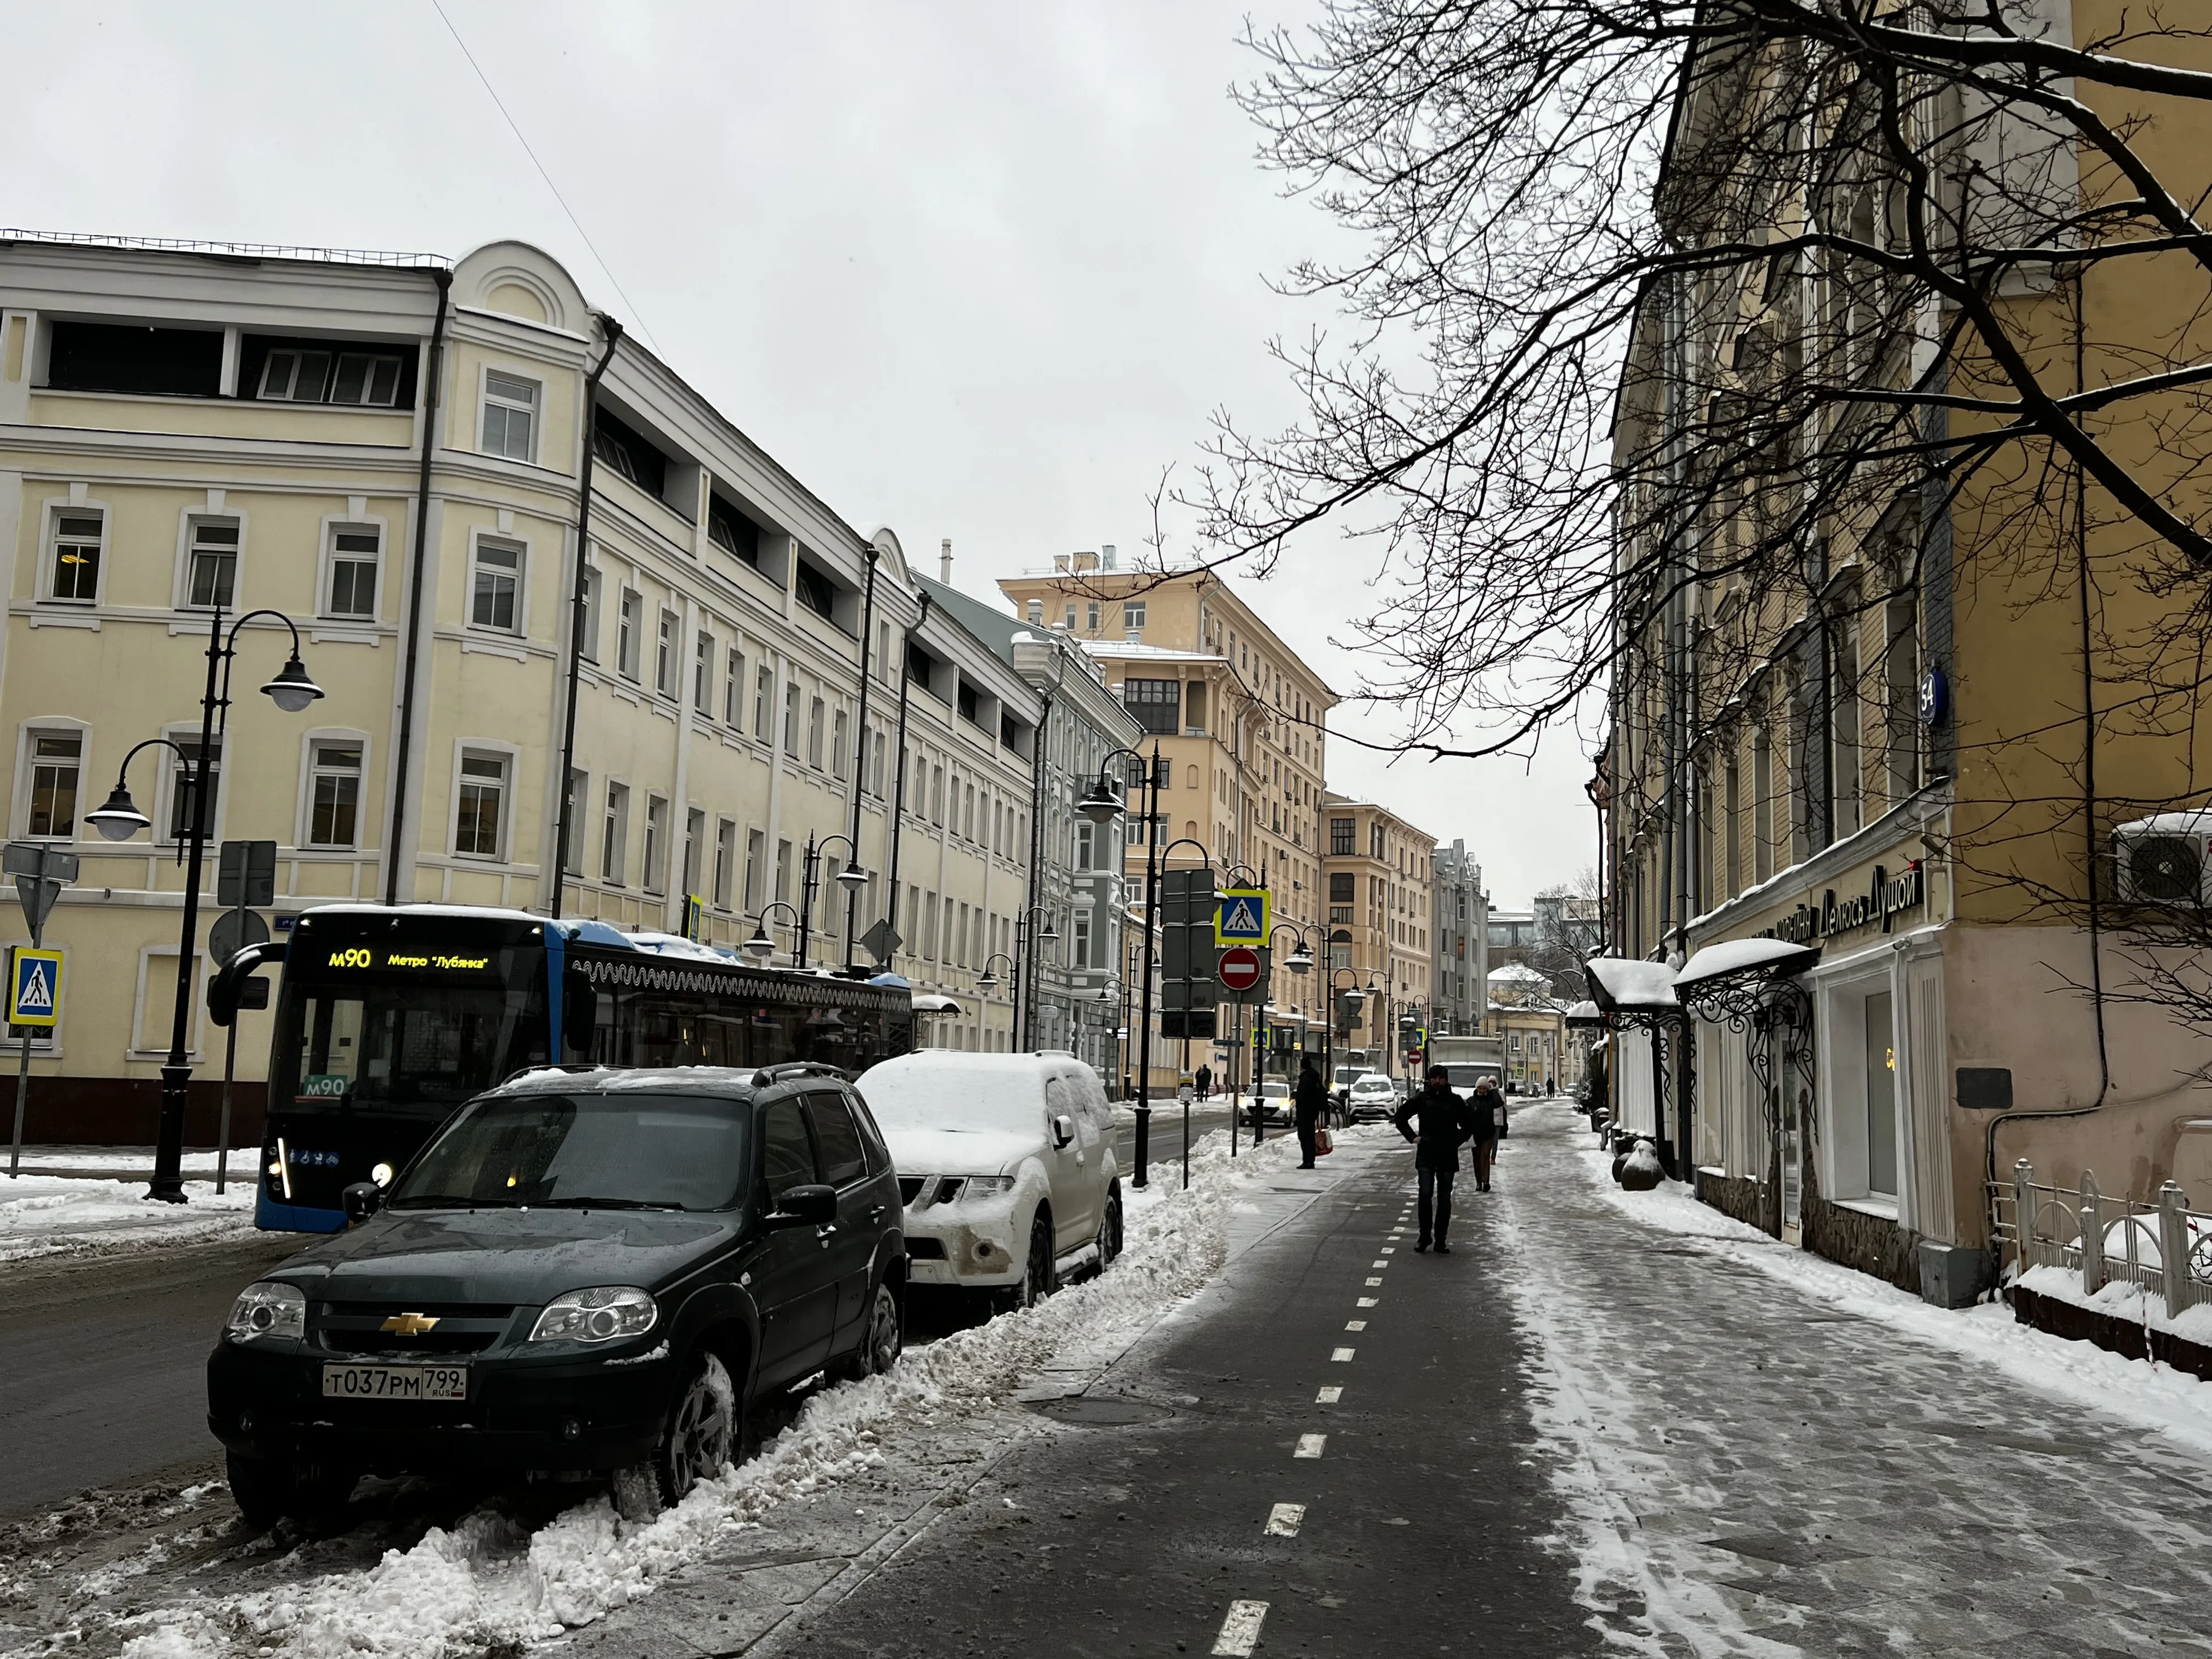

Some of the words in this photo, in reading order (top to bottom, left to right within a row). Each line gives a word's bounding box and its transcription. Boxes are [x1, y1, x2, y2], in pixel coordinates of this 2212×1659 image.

[1921, 679, 1934, 712] 54
[1818, 889, 1867, 939] Делюсь
[1866, 865, 1920, 934] Душой
[387, 955, 427, 967] Метро
[424, 1370, 460, 1390] 799
